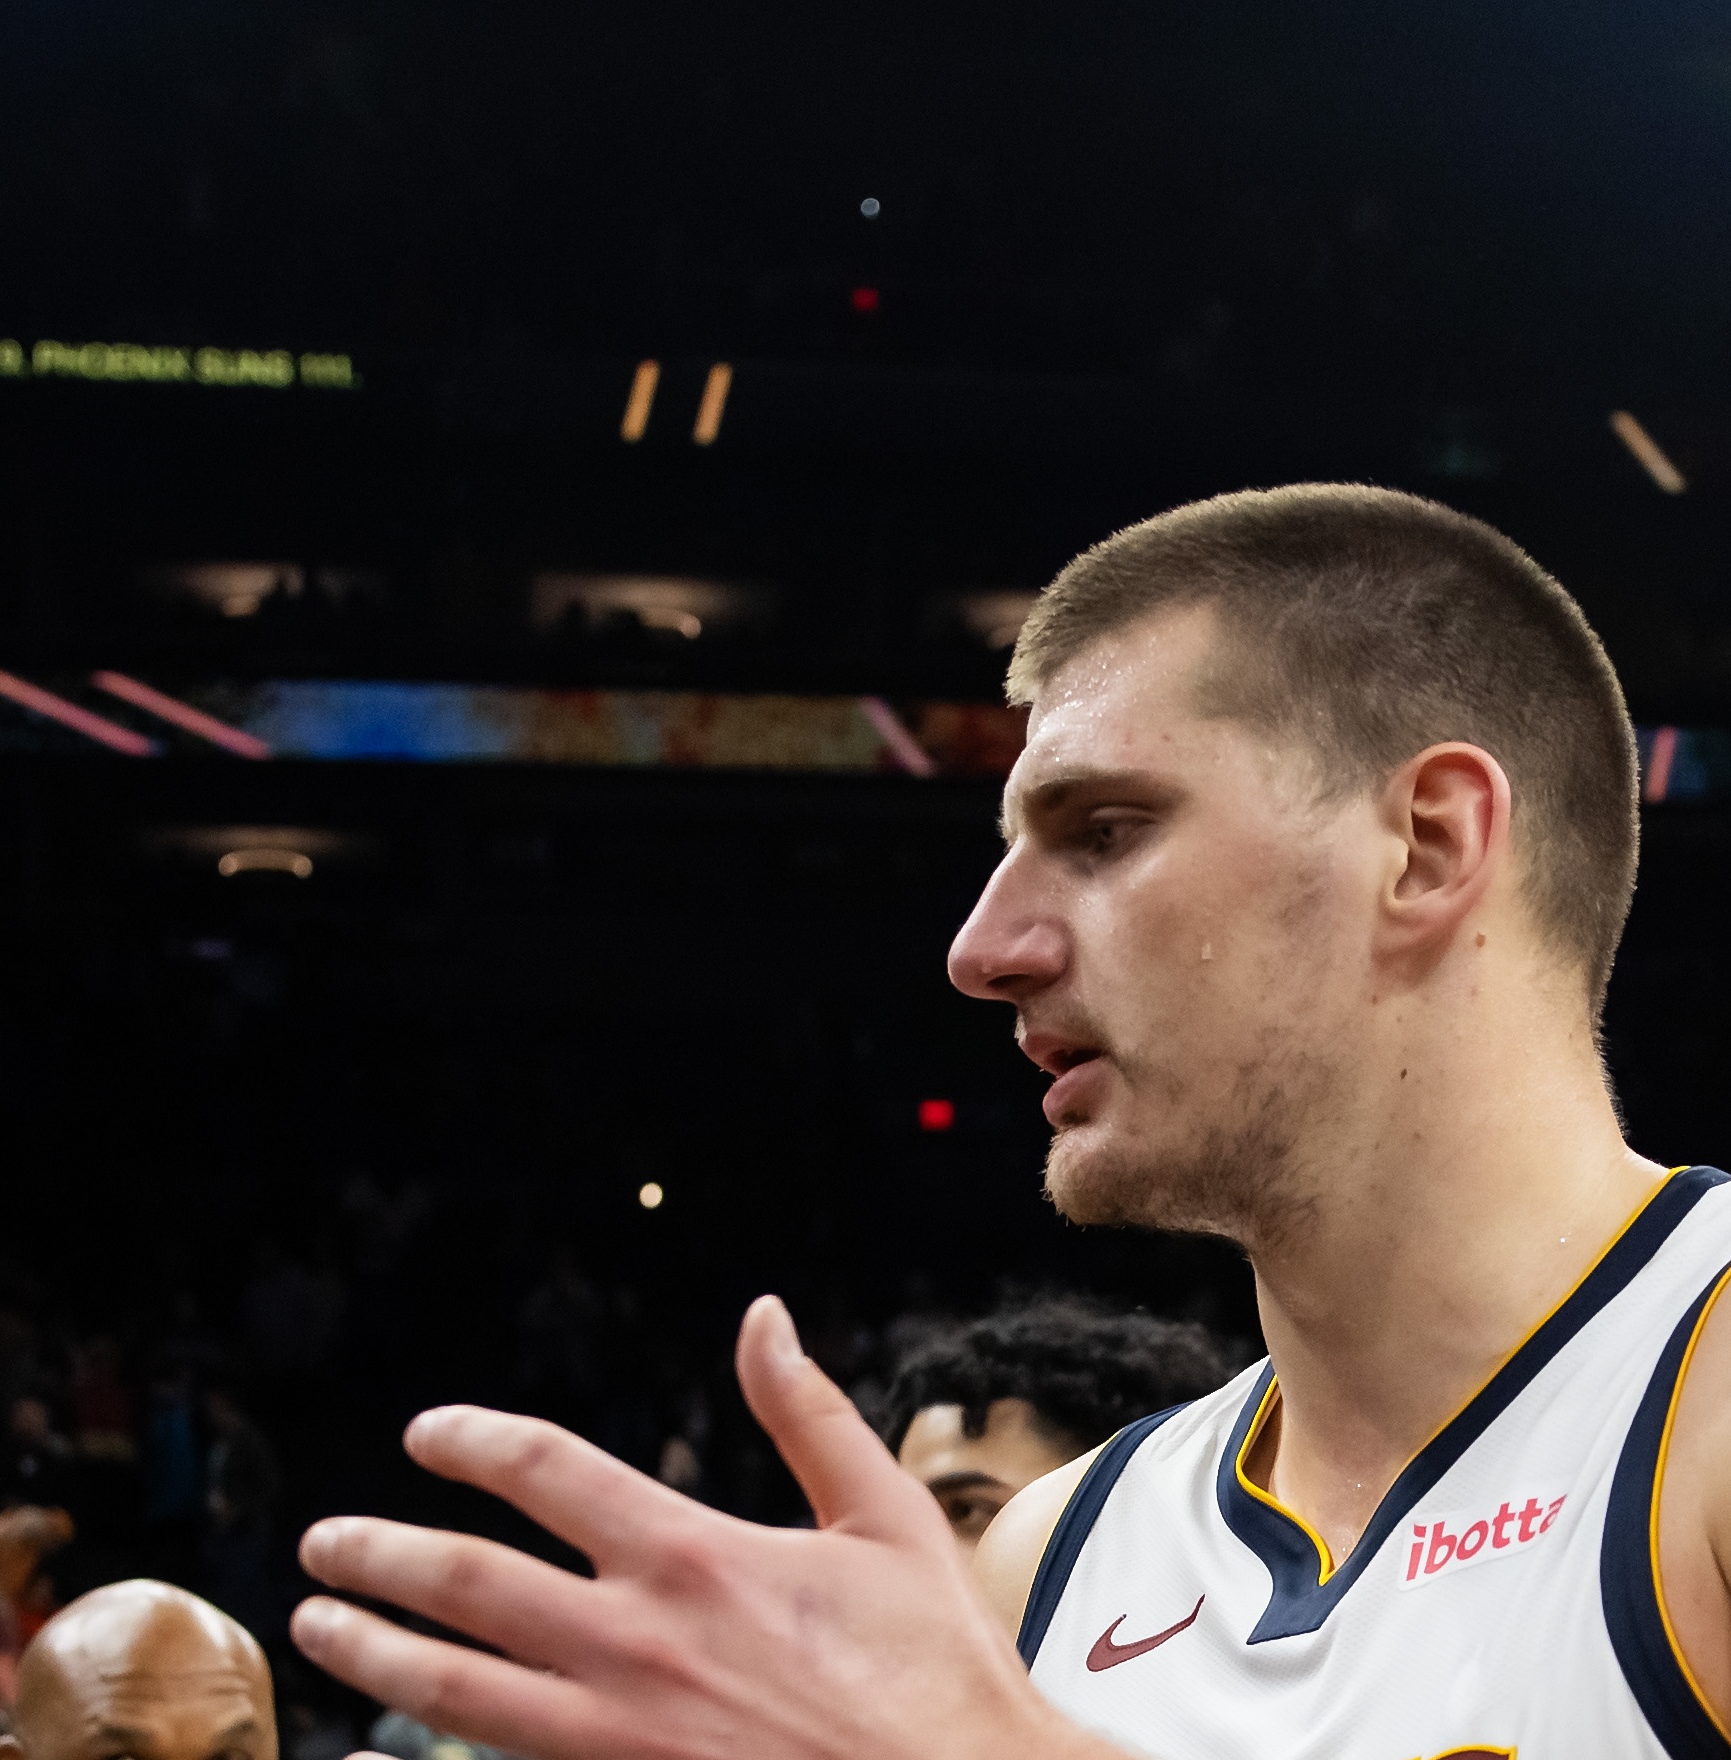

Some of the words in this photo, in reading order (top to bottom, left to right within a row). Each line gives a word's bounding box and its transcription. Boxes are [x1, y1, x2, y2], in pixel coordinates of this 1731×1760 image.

[32, 340, 191, 381] PHOENIX
[194, 346, 295, 388] SUNS
[1406, 1494, 1567, 1581] ibotta
